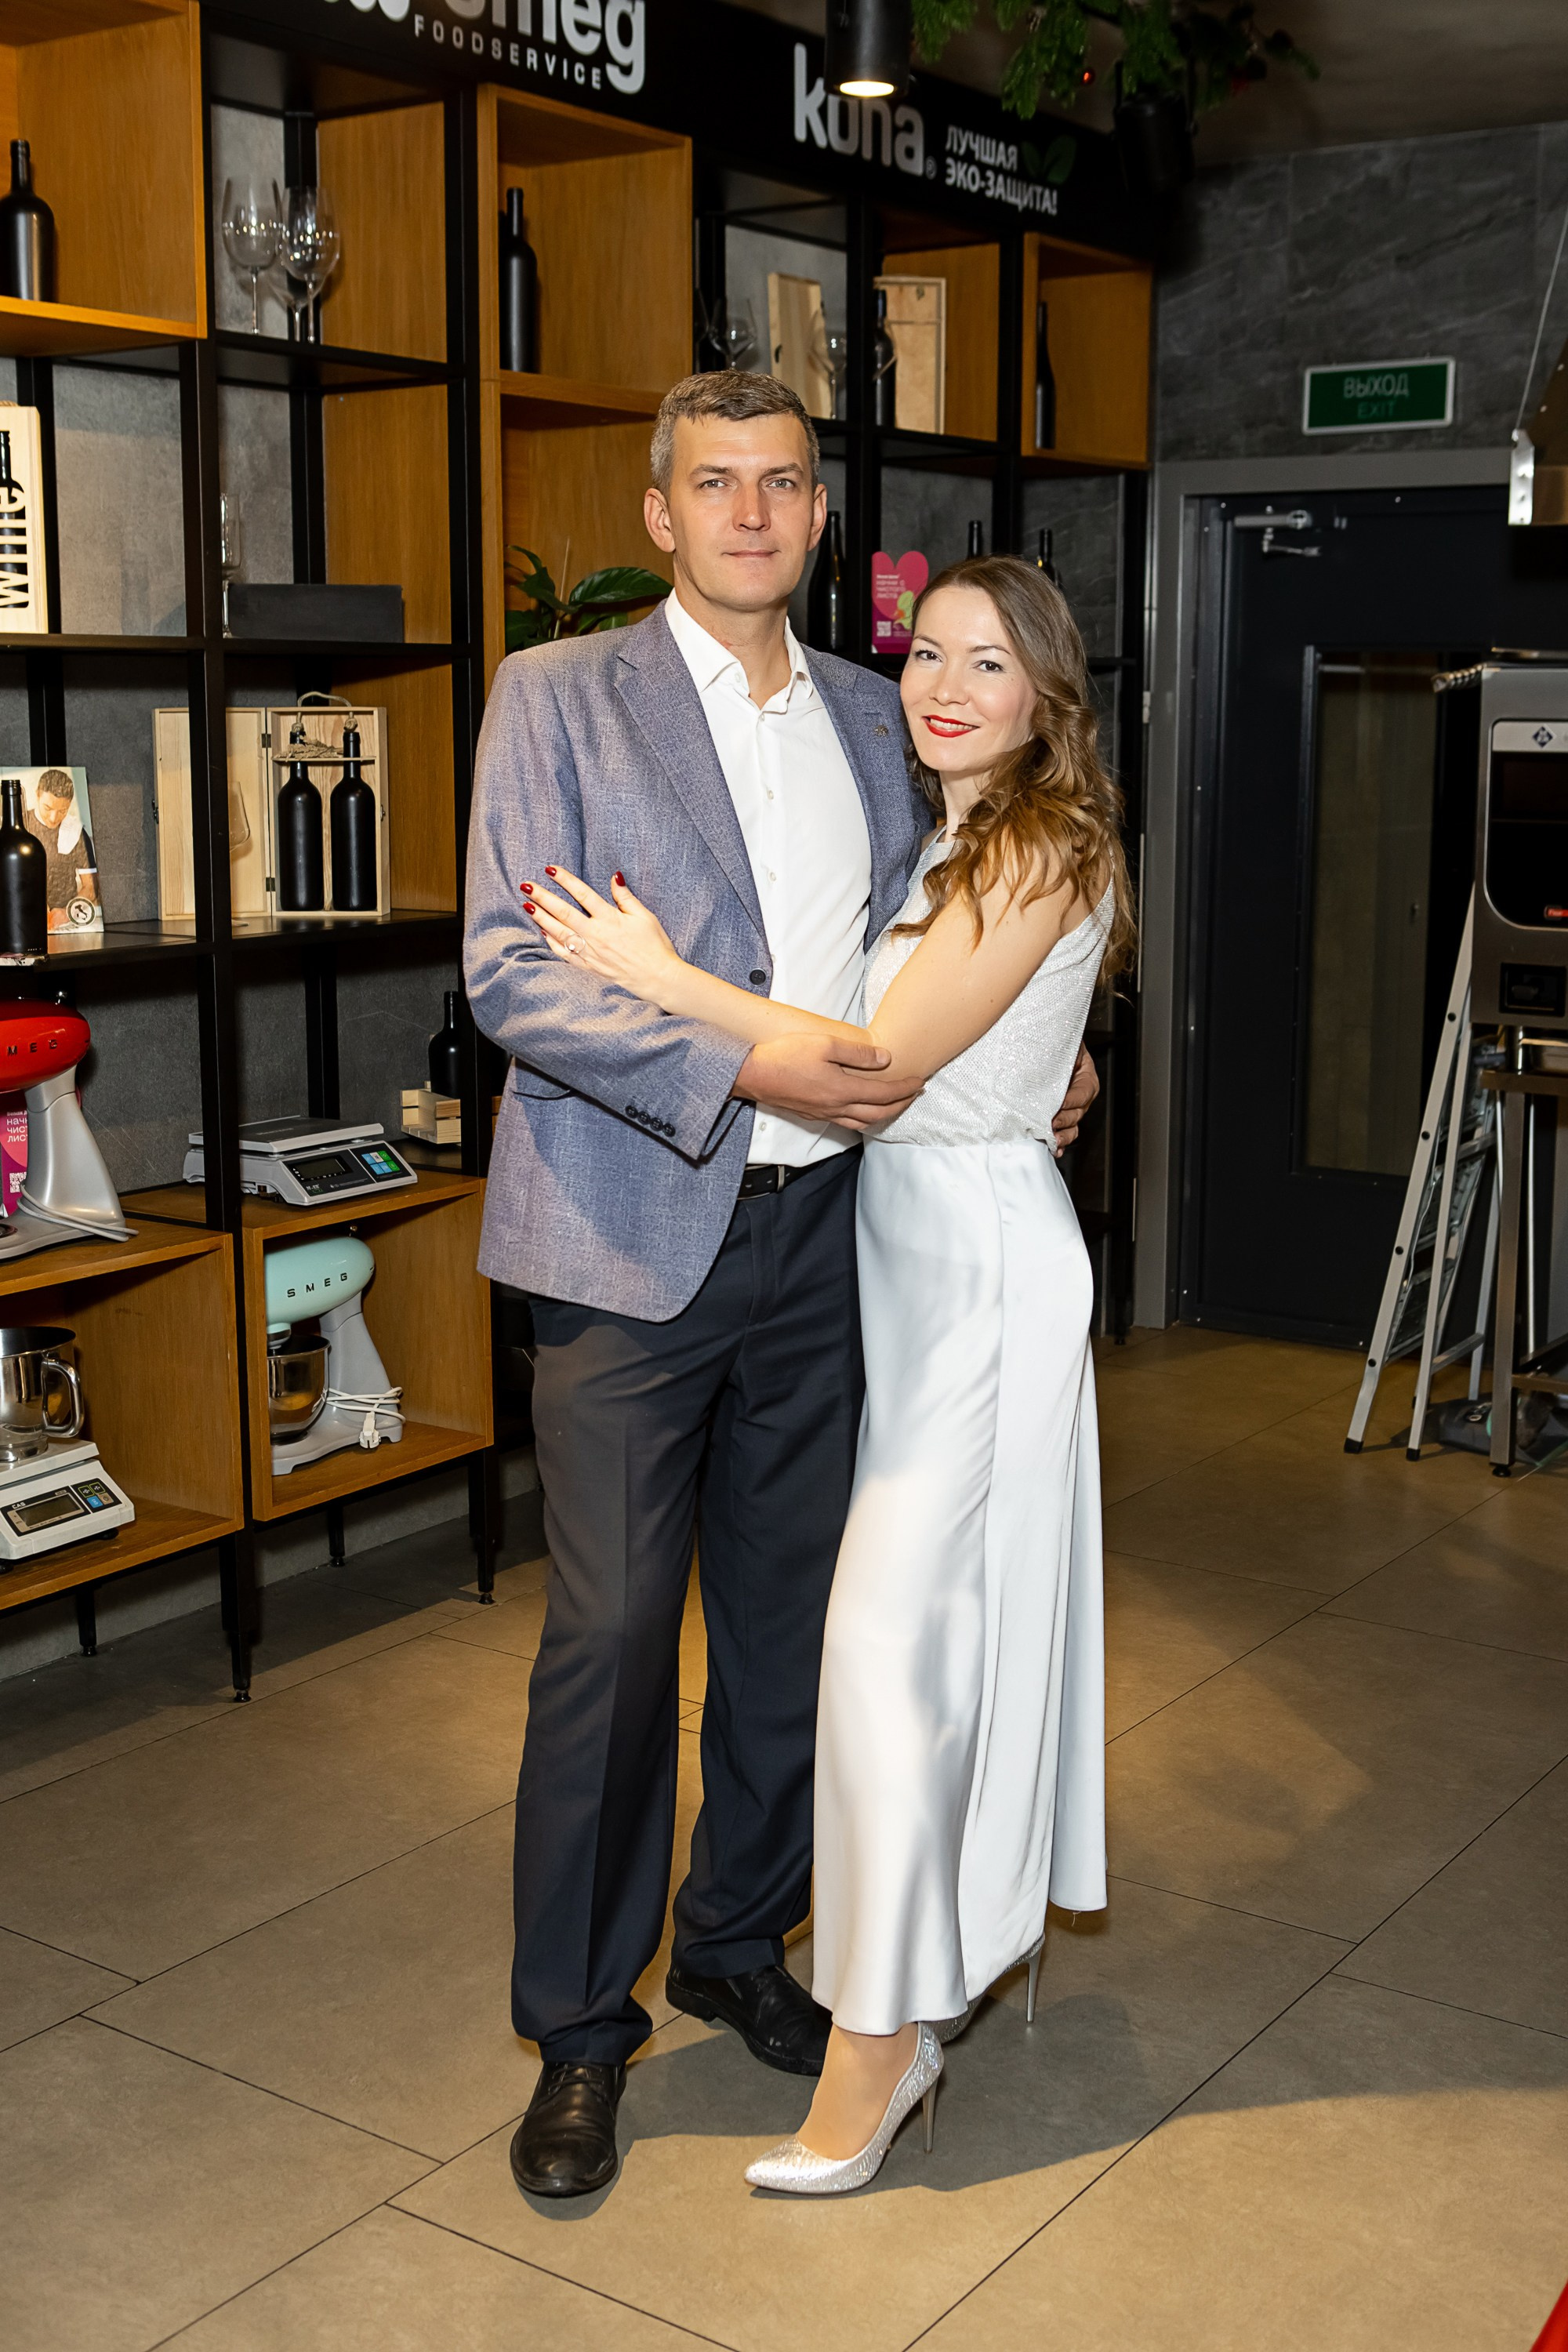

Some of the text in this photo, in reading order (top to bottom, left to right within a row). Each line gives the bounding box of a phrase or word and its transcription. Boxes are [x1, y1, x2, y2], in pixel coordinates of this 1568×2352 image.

[415, 14, 601, 90] FOODSERVICE
[946, 125, 1018, 172] ЛУЧШАЯ
[945, 157, 1058, 216] ЭКО-ЗАЩИТА!
[1343, 372, 1410, 398] ВЫХОД
[1357, 400, 1396, 419] EXIT
[287, 1272, 348, 1298] SMEG
